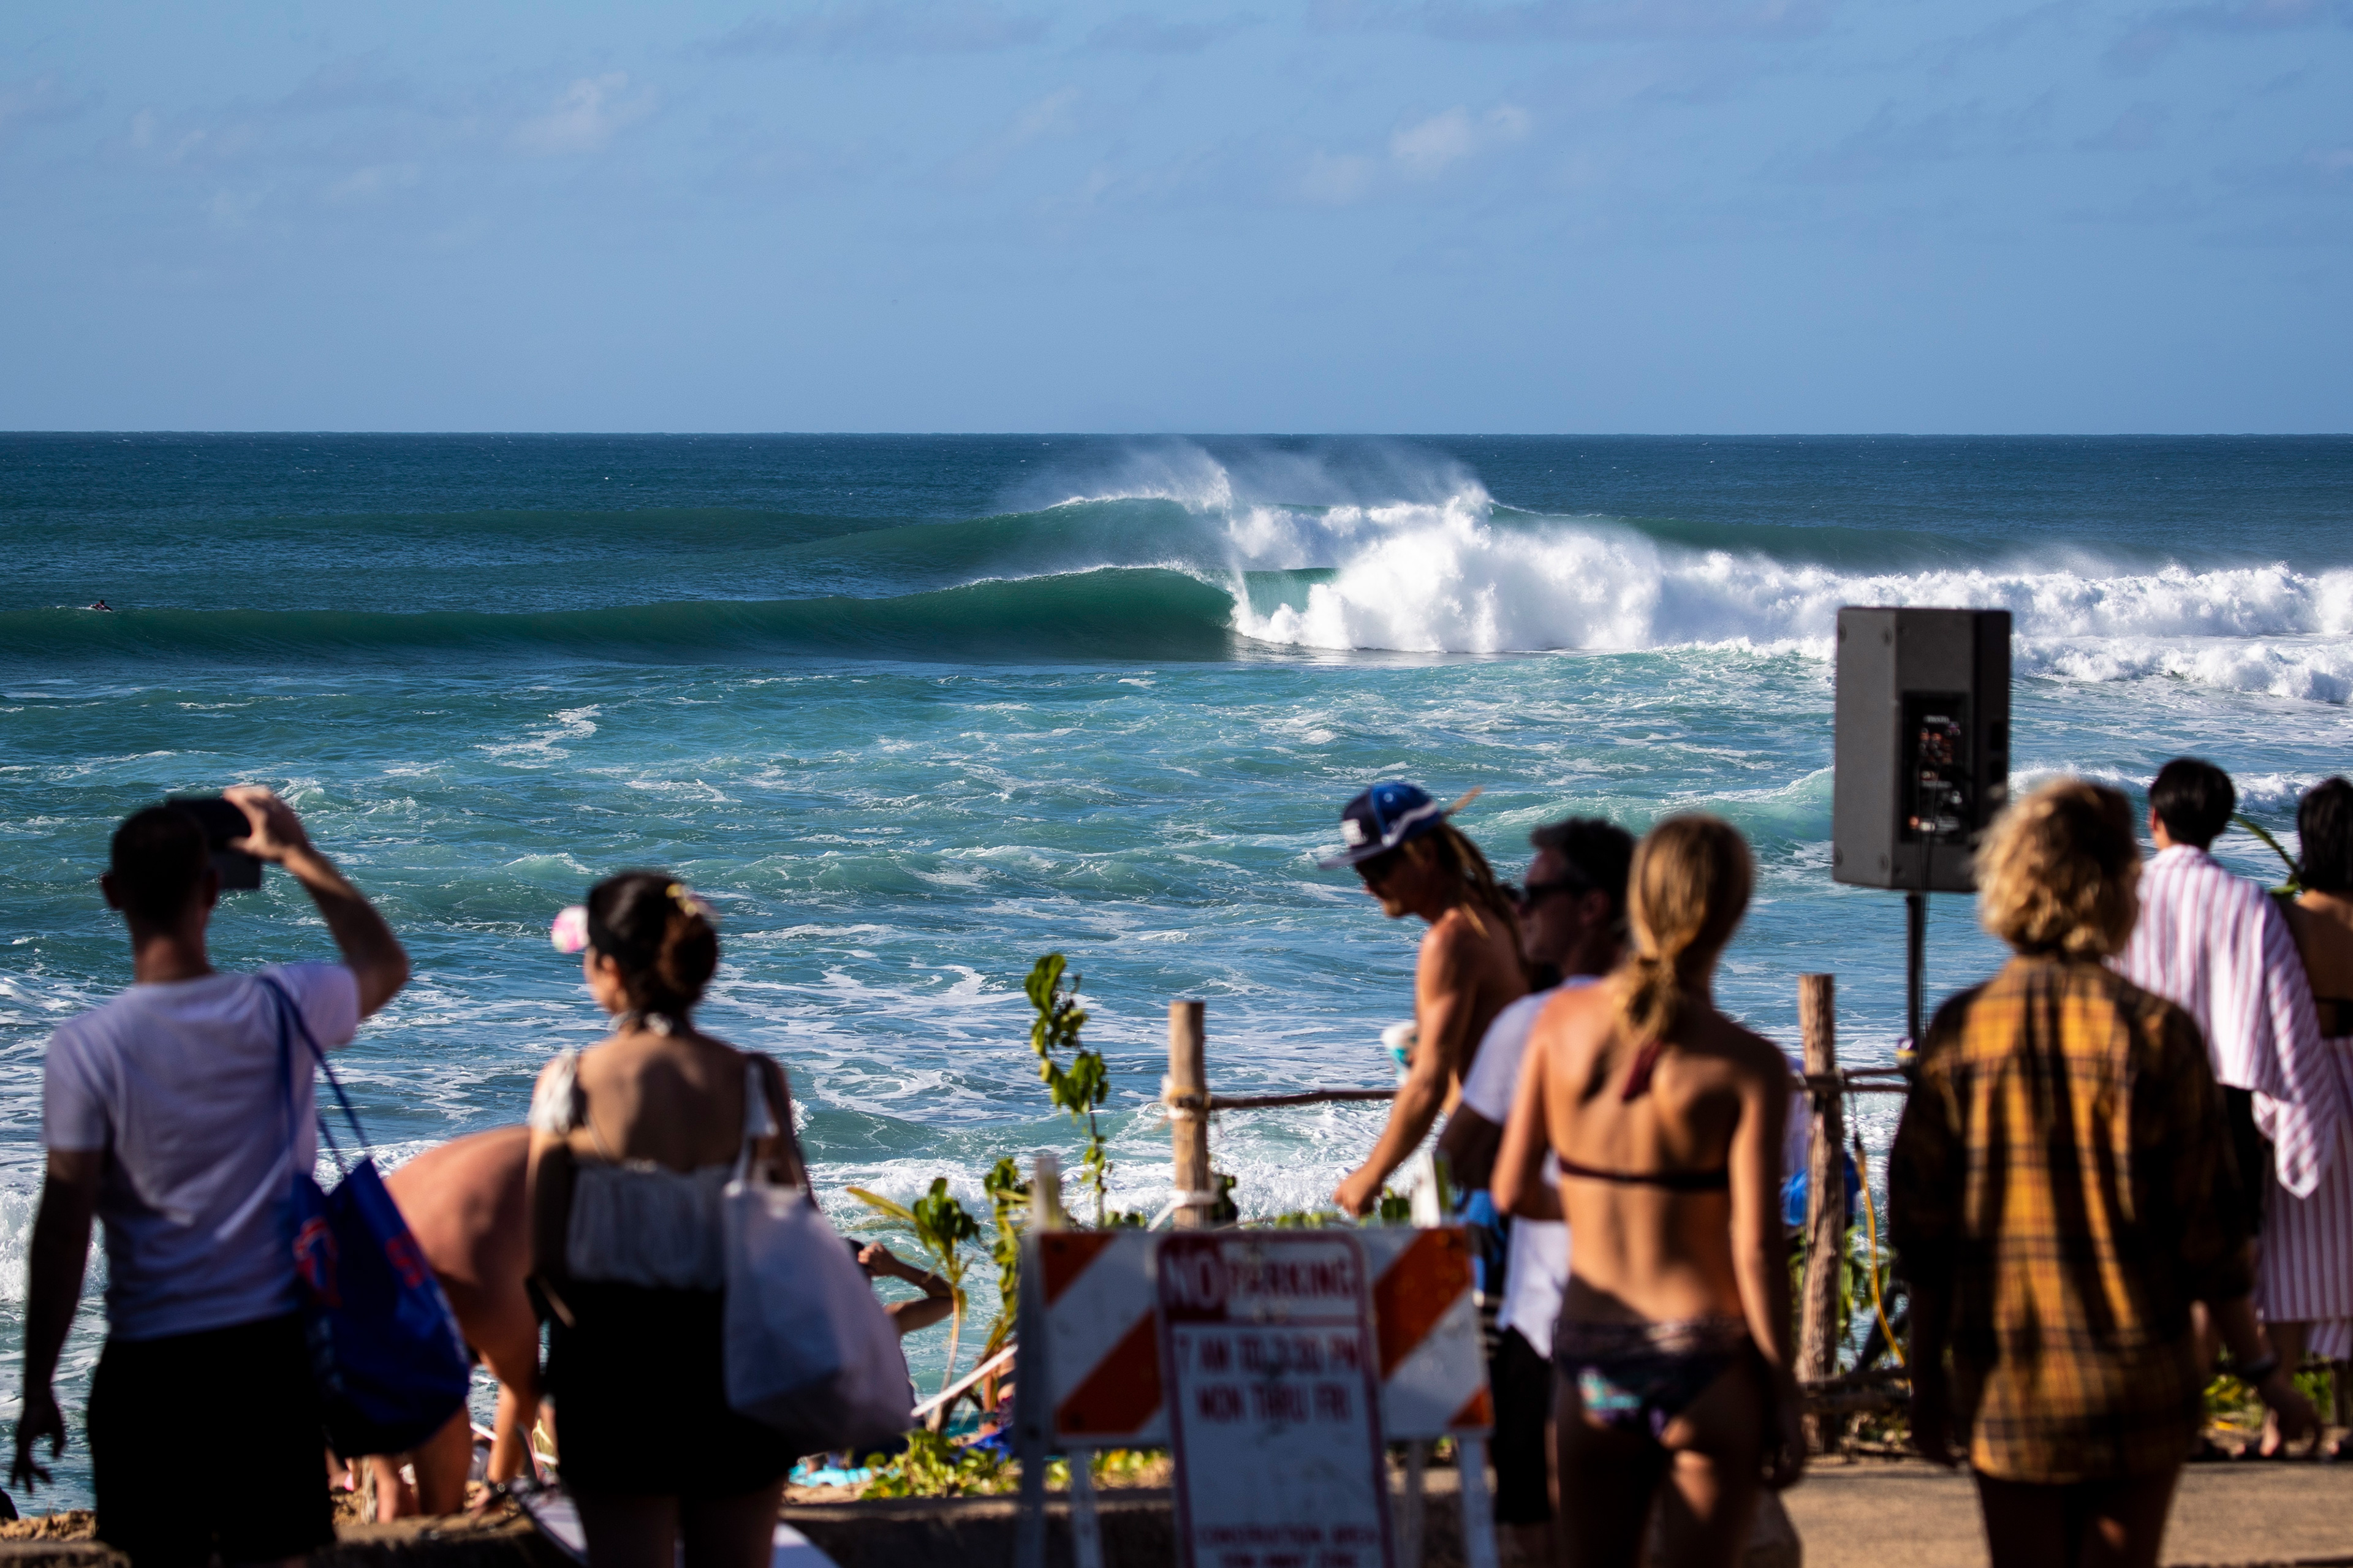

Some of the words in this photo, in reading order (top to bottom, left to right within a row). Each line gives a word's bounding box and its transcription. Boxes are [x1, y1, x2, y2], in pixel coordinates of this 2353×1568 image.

[1165, 1252, 1220, 1309] NO
[1227, 1260, 1358, 1300] PARKING
[1197, 1385, 1245, 1420] MON
[1251, 1384, 1308, 1422] THRU
[1316, 1384, 1349, 1421] FRI
